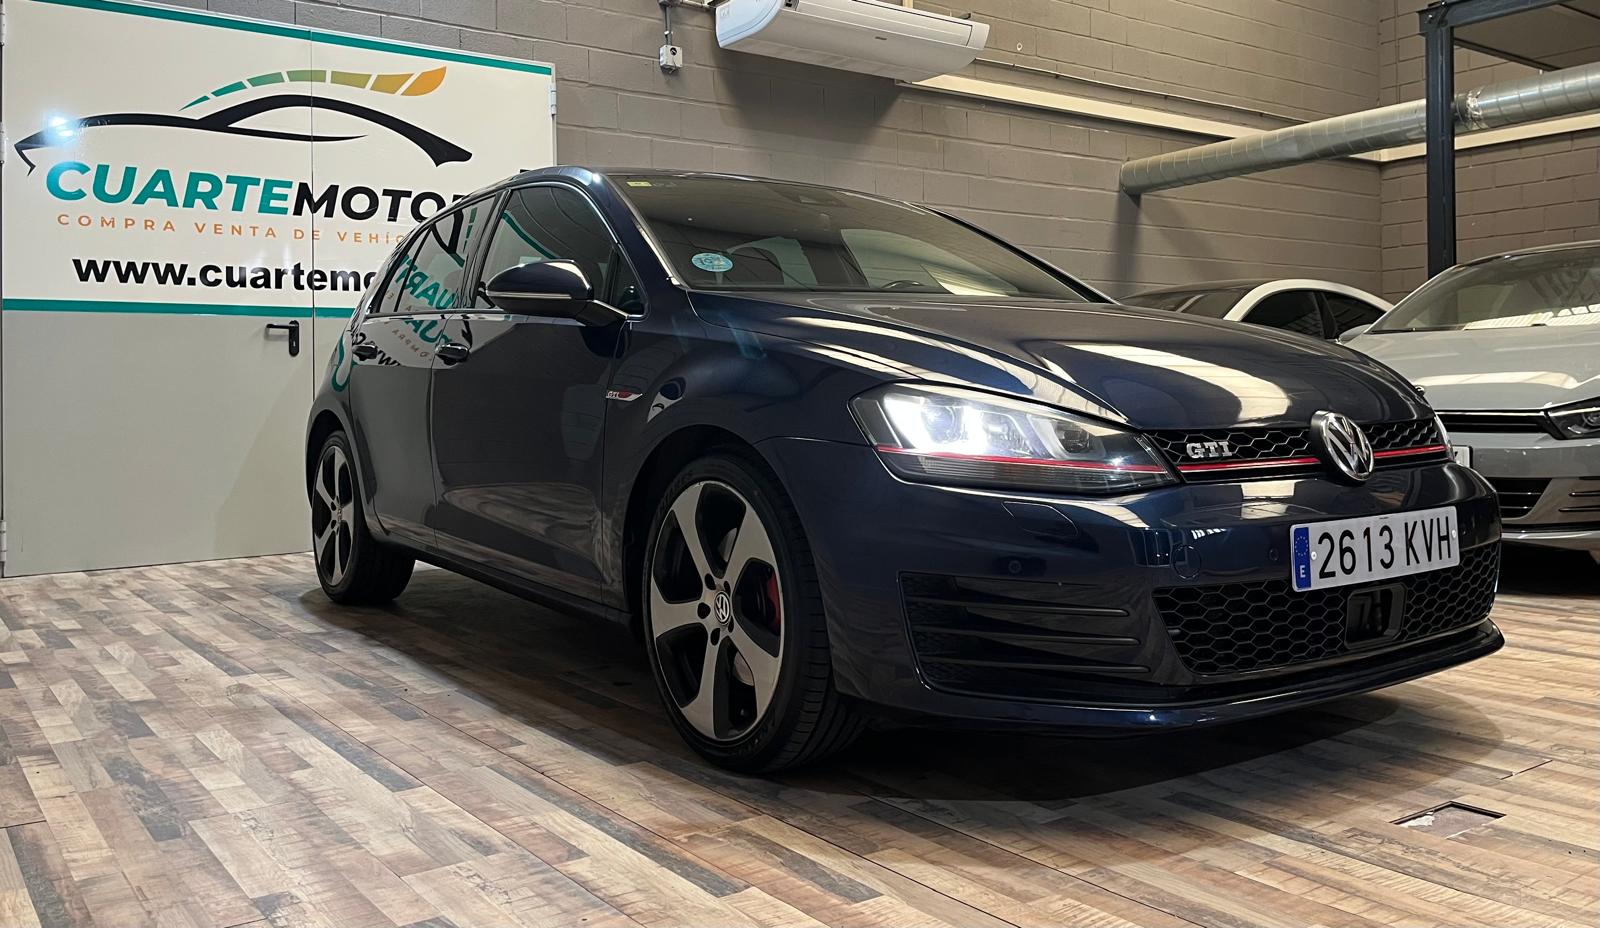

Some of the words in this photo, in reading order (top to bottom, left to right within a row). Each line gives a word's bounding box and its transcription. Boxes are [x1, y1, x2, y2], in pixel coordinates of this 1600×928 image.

[46, 161, 465, 223] CUARTEMOTO
[57, 214, 175, 232] COMPRA
[194, 222, 277, 238] VENTA
[293, 228, 321, 241] DE
[1186, 441, 1233, 459] GTI
[1318, 525, 1395, 579] 2613
[1404, 516, 1452, 566] KVH
[1300, 565, 1306, 578] E
